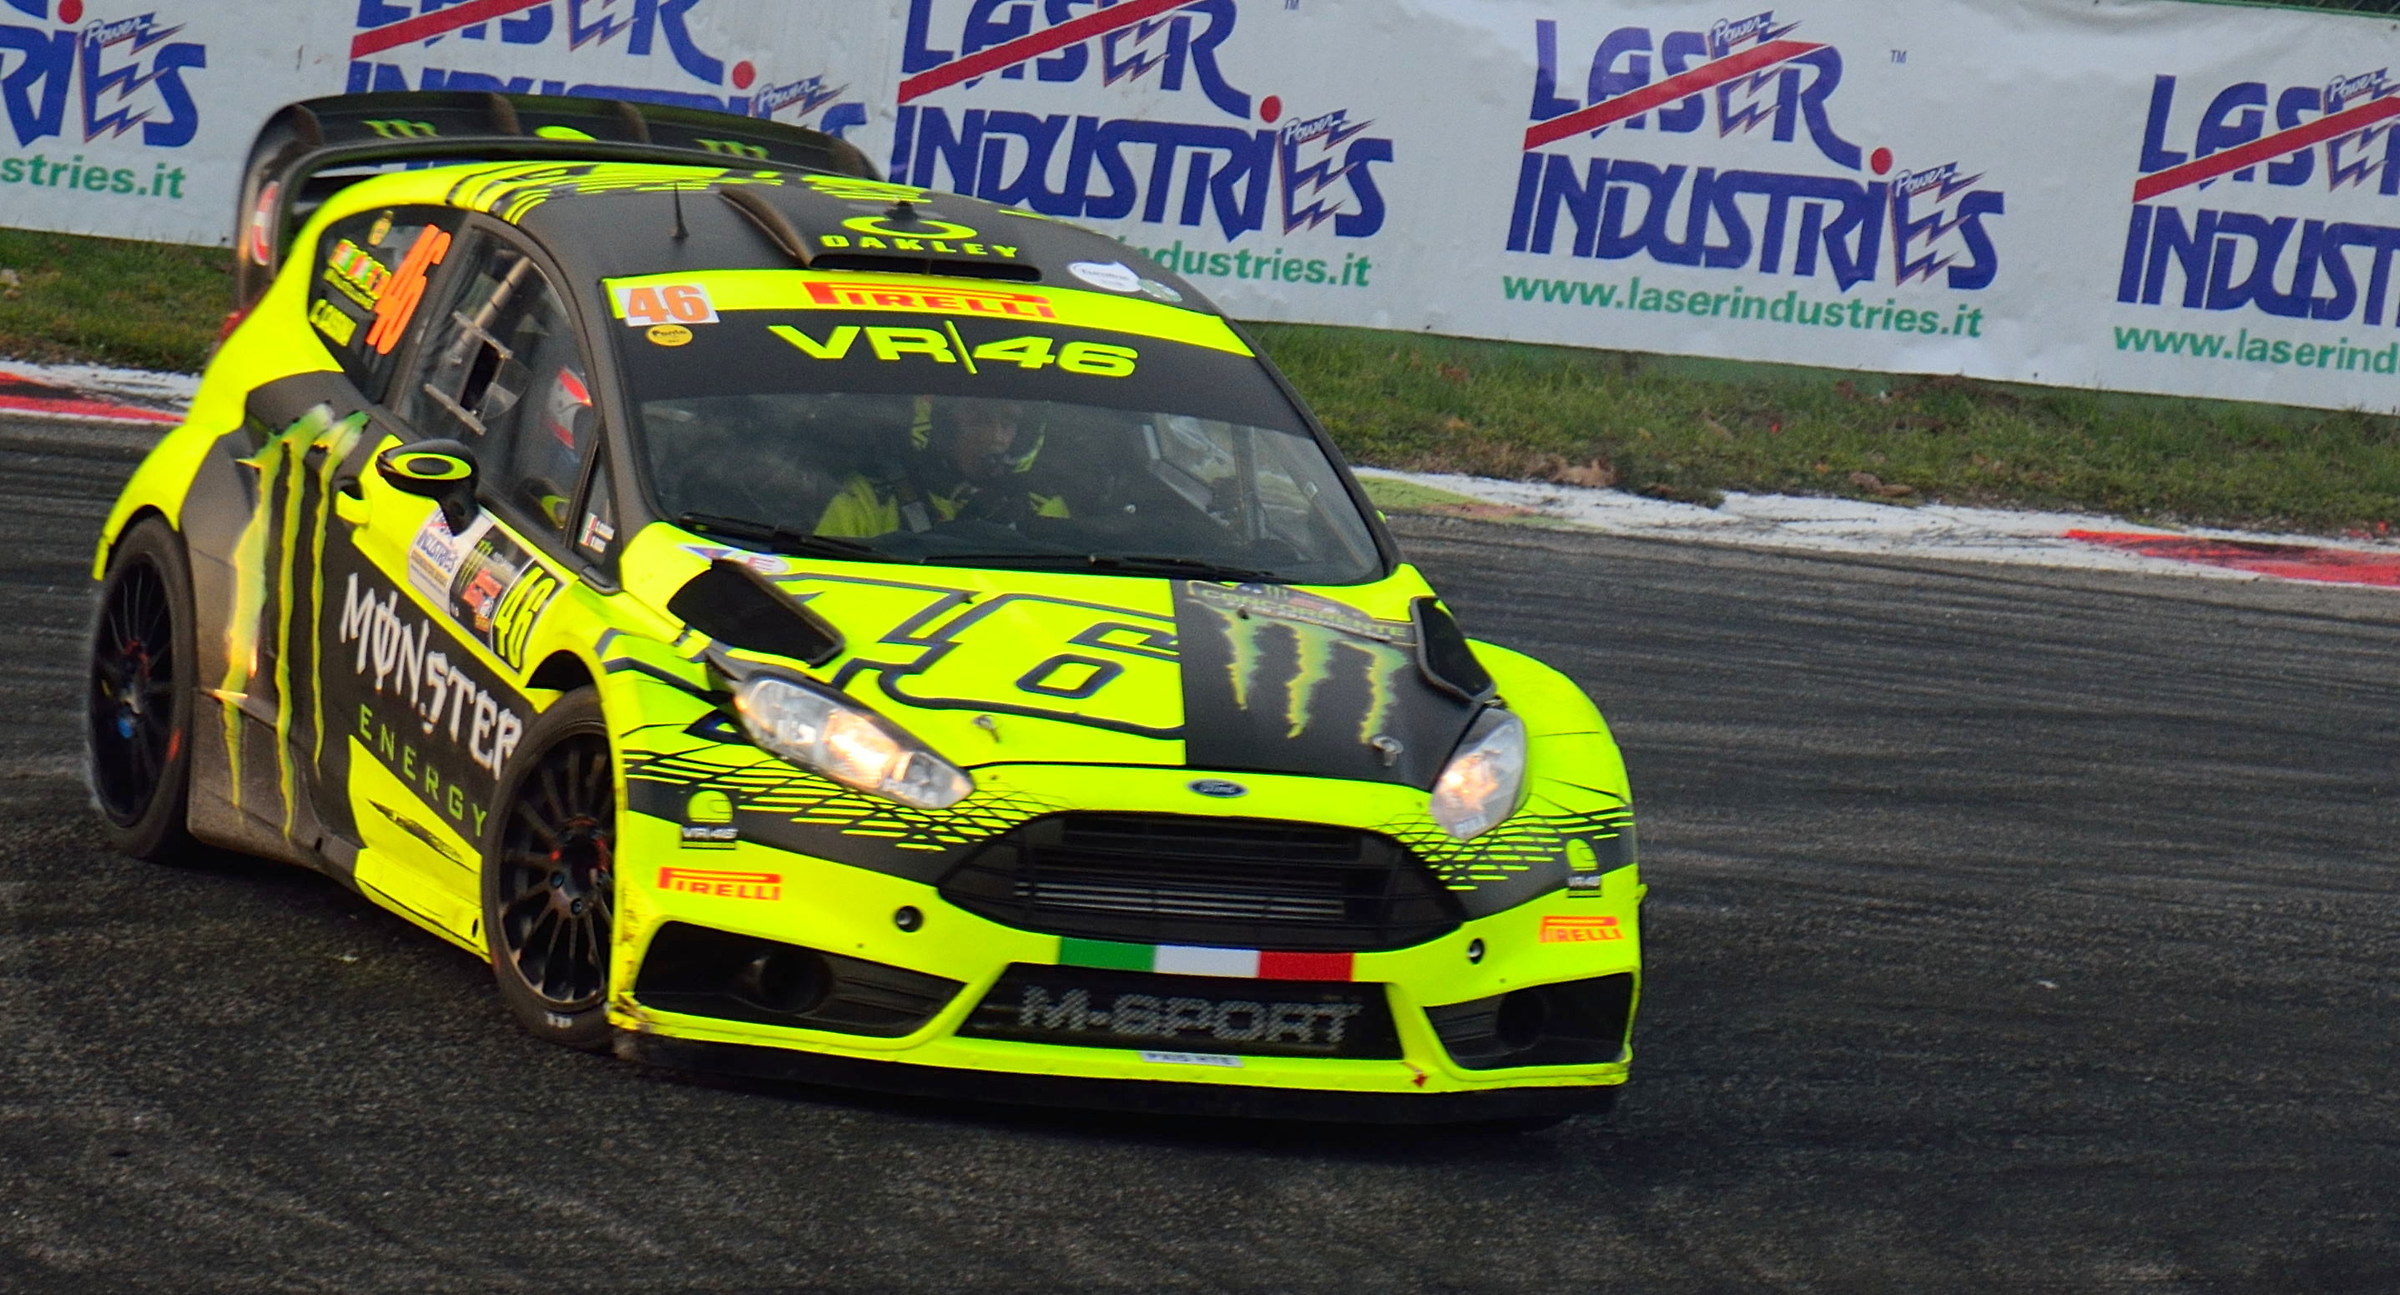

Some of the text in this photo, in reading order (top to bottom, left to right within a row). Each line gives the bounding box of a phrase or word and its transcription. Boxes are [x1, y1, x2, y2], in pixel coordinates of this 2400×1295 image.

[1530, 11, 1862, 171] LASER
[2138, 67, 2400, 196] LASE
[820, 235, 1020, 258] OAKLEY
[628, 285, 710, 323] 46
[802, 281, 1056, 319] PIRELLI
[1502, 275, 1984, 338] www.laserindustries.it
[495, 565, 556, 669] 46
[359, 703, 487, 837] ENERGY
[658, 866, 782, 901] PIRELLI
[1540, 915, 1625, 943] PIRELLI
[1018, 985, 1364, 1043] M-SPORT
